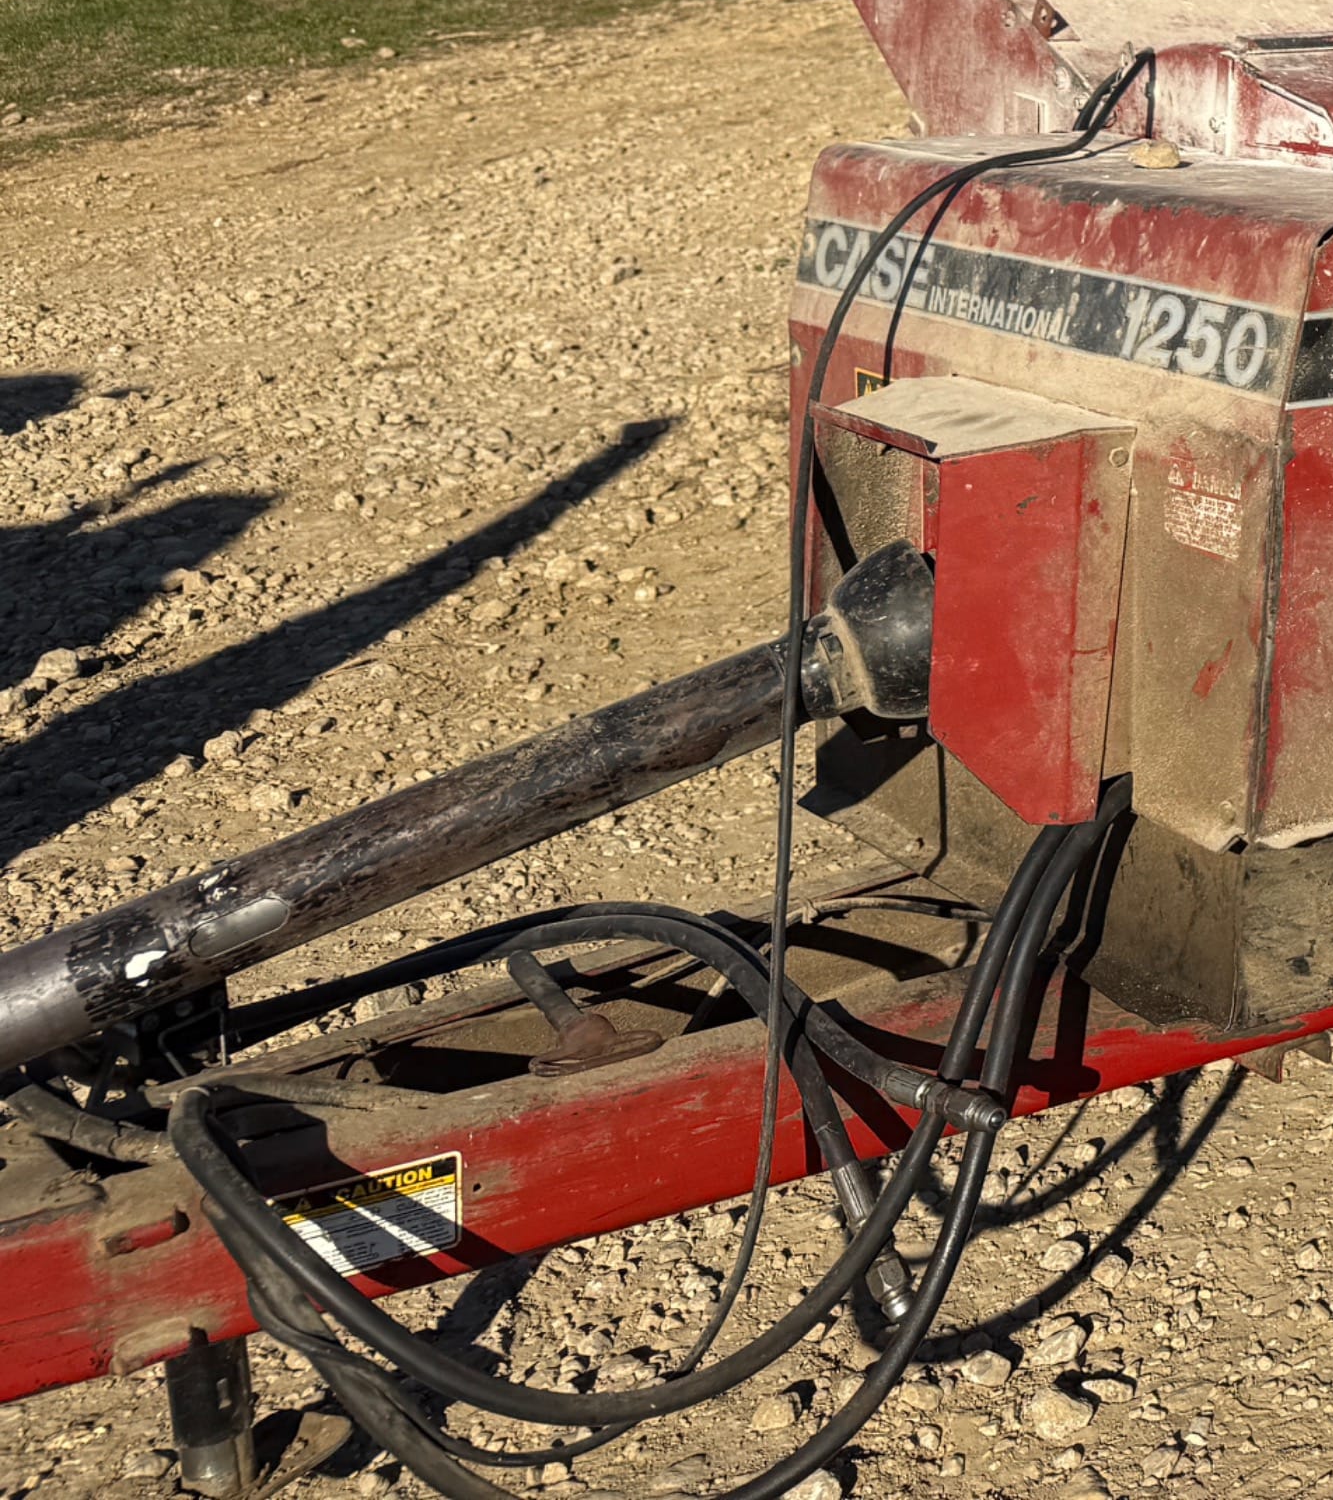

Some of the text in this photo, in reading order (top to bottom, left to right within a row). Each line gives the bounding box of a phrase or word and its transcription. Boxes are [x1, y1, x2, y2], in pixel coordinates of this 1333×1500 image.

[815, 224, 1268, 388] CASE INTERNATIONAL 1250
[337, 1166, 433, 1199] CAUTION
